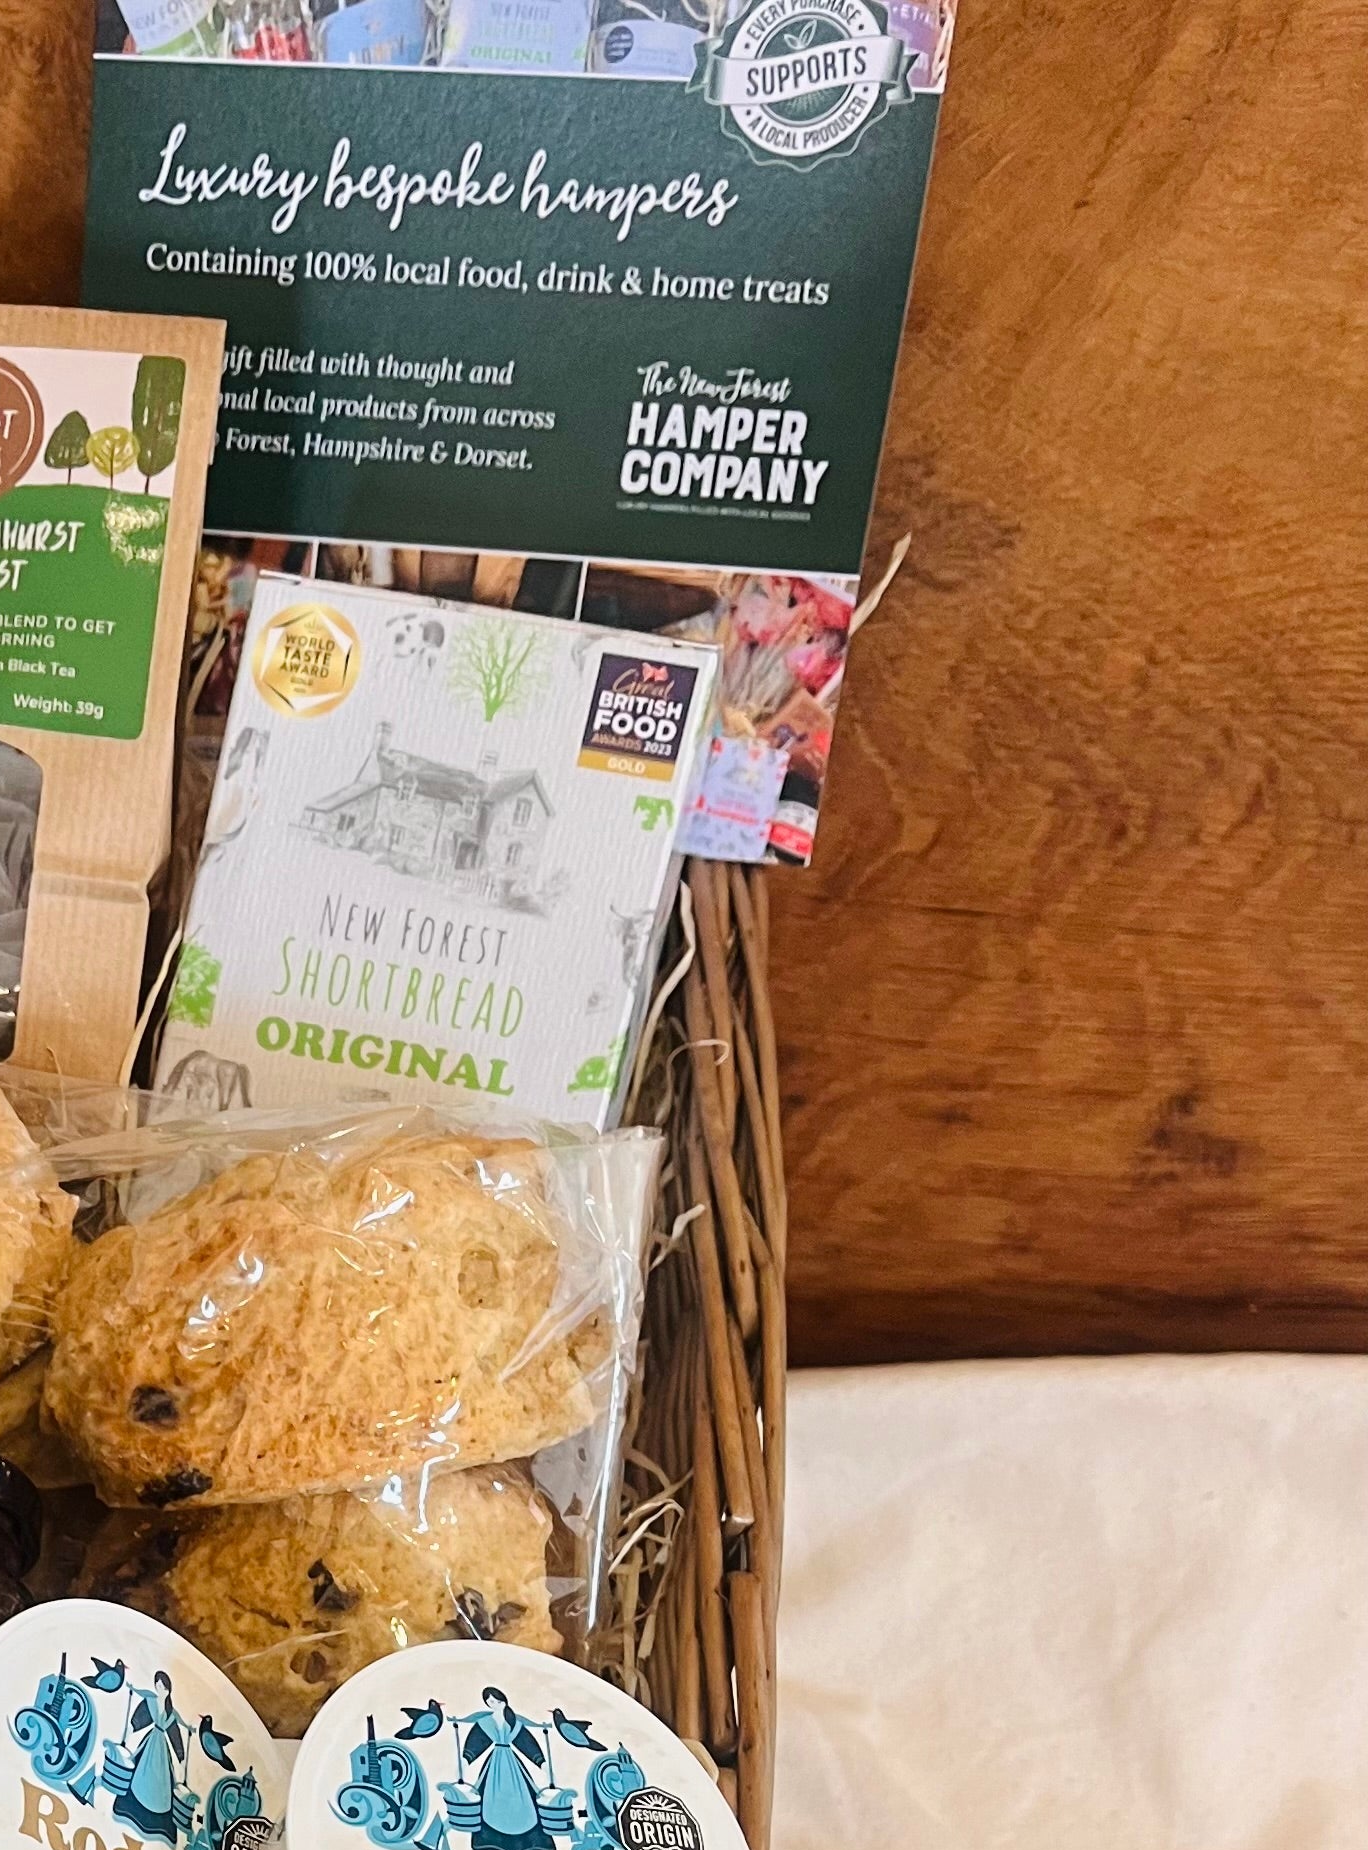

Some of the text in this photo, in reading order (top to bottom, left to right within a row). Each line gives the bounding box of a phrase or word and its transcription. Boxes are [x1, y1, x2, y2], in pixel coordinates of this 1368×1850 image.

[747, 1, 787, 42] EVERY
[746, 46, 867, 97] SUPPORTS
[758, 97, 867, 150] LOCAL PRODUCER
[138, 122, 740, 241] Luxury bespoke hampers
[146, 243, 830, 305] Containing 100% local food, drink & home treats
[637, 361, 792, 404] The New Forest
[627, 401, 808, 456] HAMPER
[620, 449, 829, 505] COMPANY
[54, 616, 77, 631] TO
[82, 619, 116, 636] GET
[286, 633, 335, 652] WORLD
[8, 658, 46, 674] Black
[51, 663, 76, 678] Tea
[279, 662, 329, 678] AWARD
[284, 646, 332, 665] TASTE
[13, 693, 104, 719] Weight: 39g
[593, 689, 683, 743] BRITISH FOOD
[591, 732, 672, 756] AWARDS 2023
[607, 757, 646, 775] GOLD
[319, 894, 508, 967] NEW FOREST
[273, 936, 524, 1038] SHORTBREAD
[255, 1016, 515, 1097] ORIGINAL
[630, 1809, 687, 1825] DESIGNATED
[630, 1822, 694, 1849] ORIGIN
